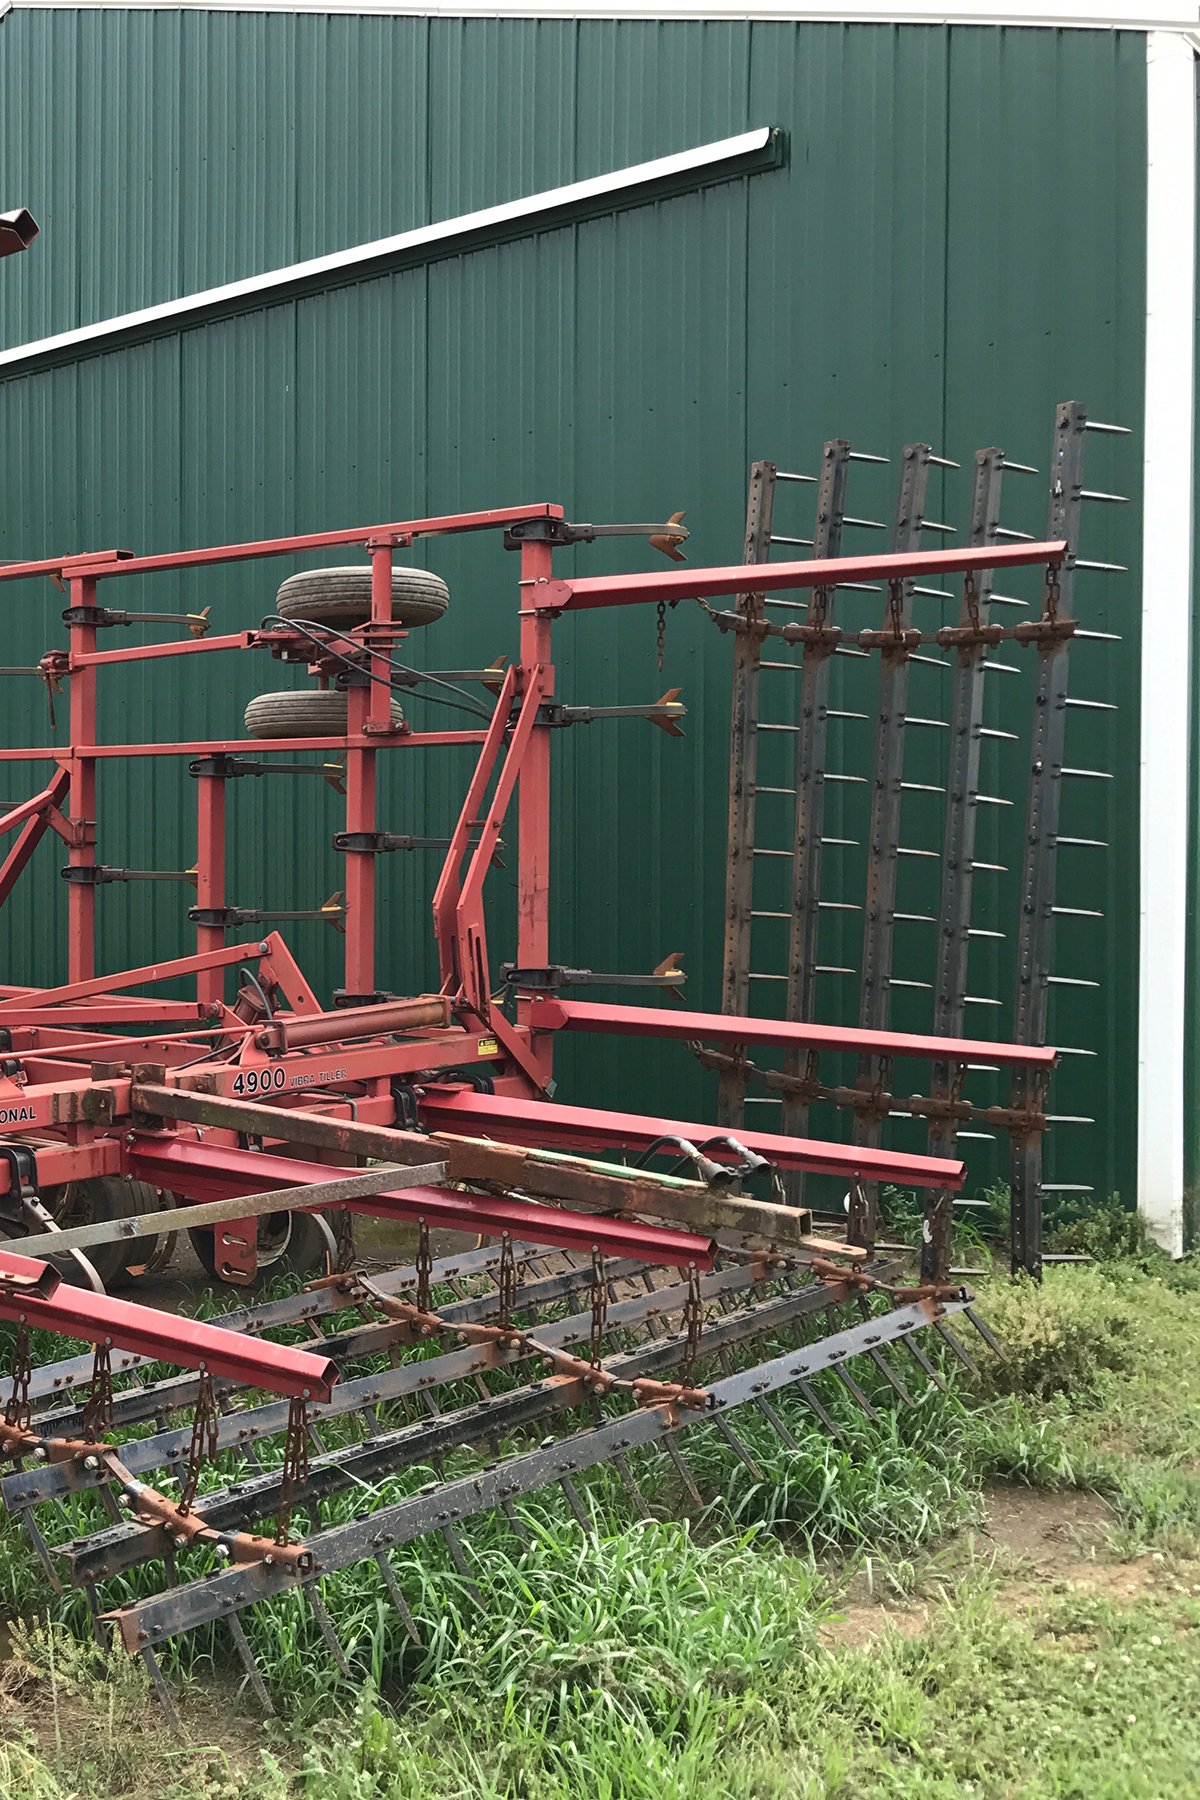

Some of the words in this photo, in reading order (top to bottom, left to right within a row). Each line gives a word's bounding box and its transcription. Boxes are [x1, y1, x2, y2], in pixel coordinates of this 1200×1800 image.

[233, 1066, 286, 1096] 4900
[290, 1074, 315, 1086] VIBRA
[319, 1069, 347, 1082] TILLER
